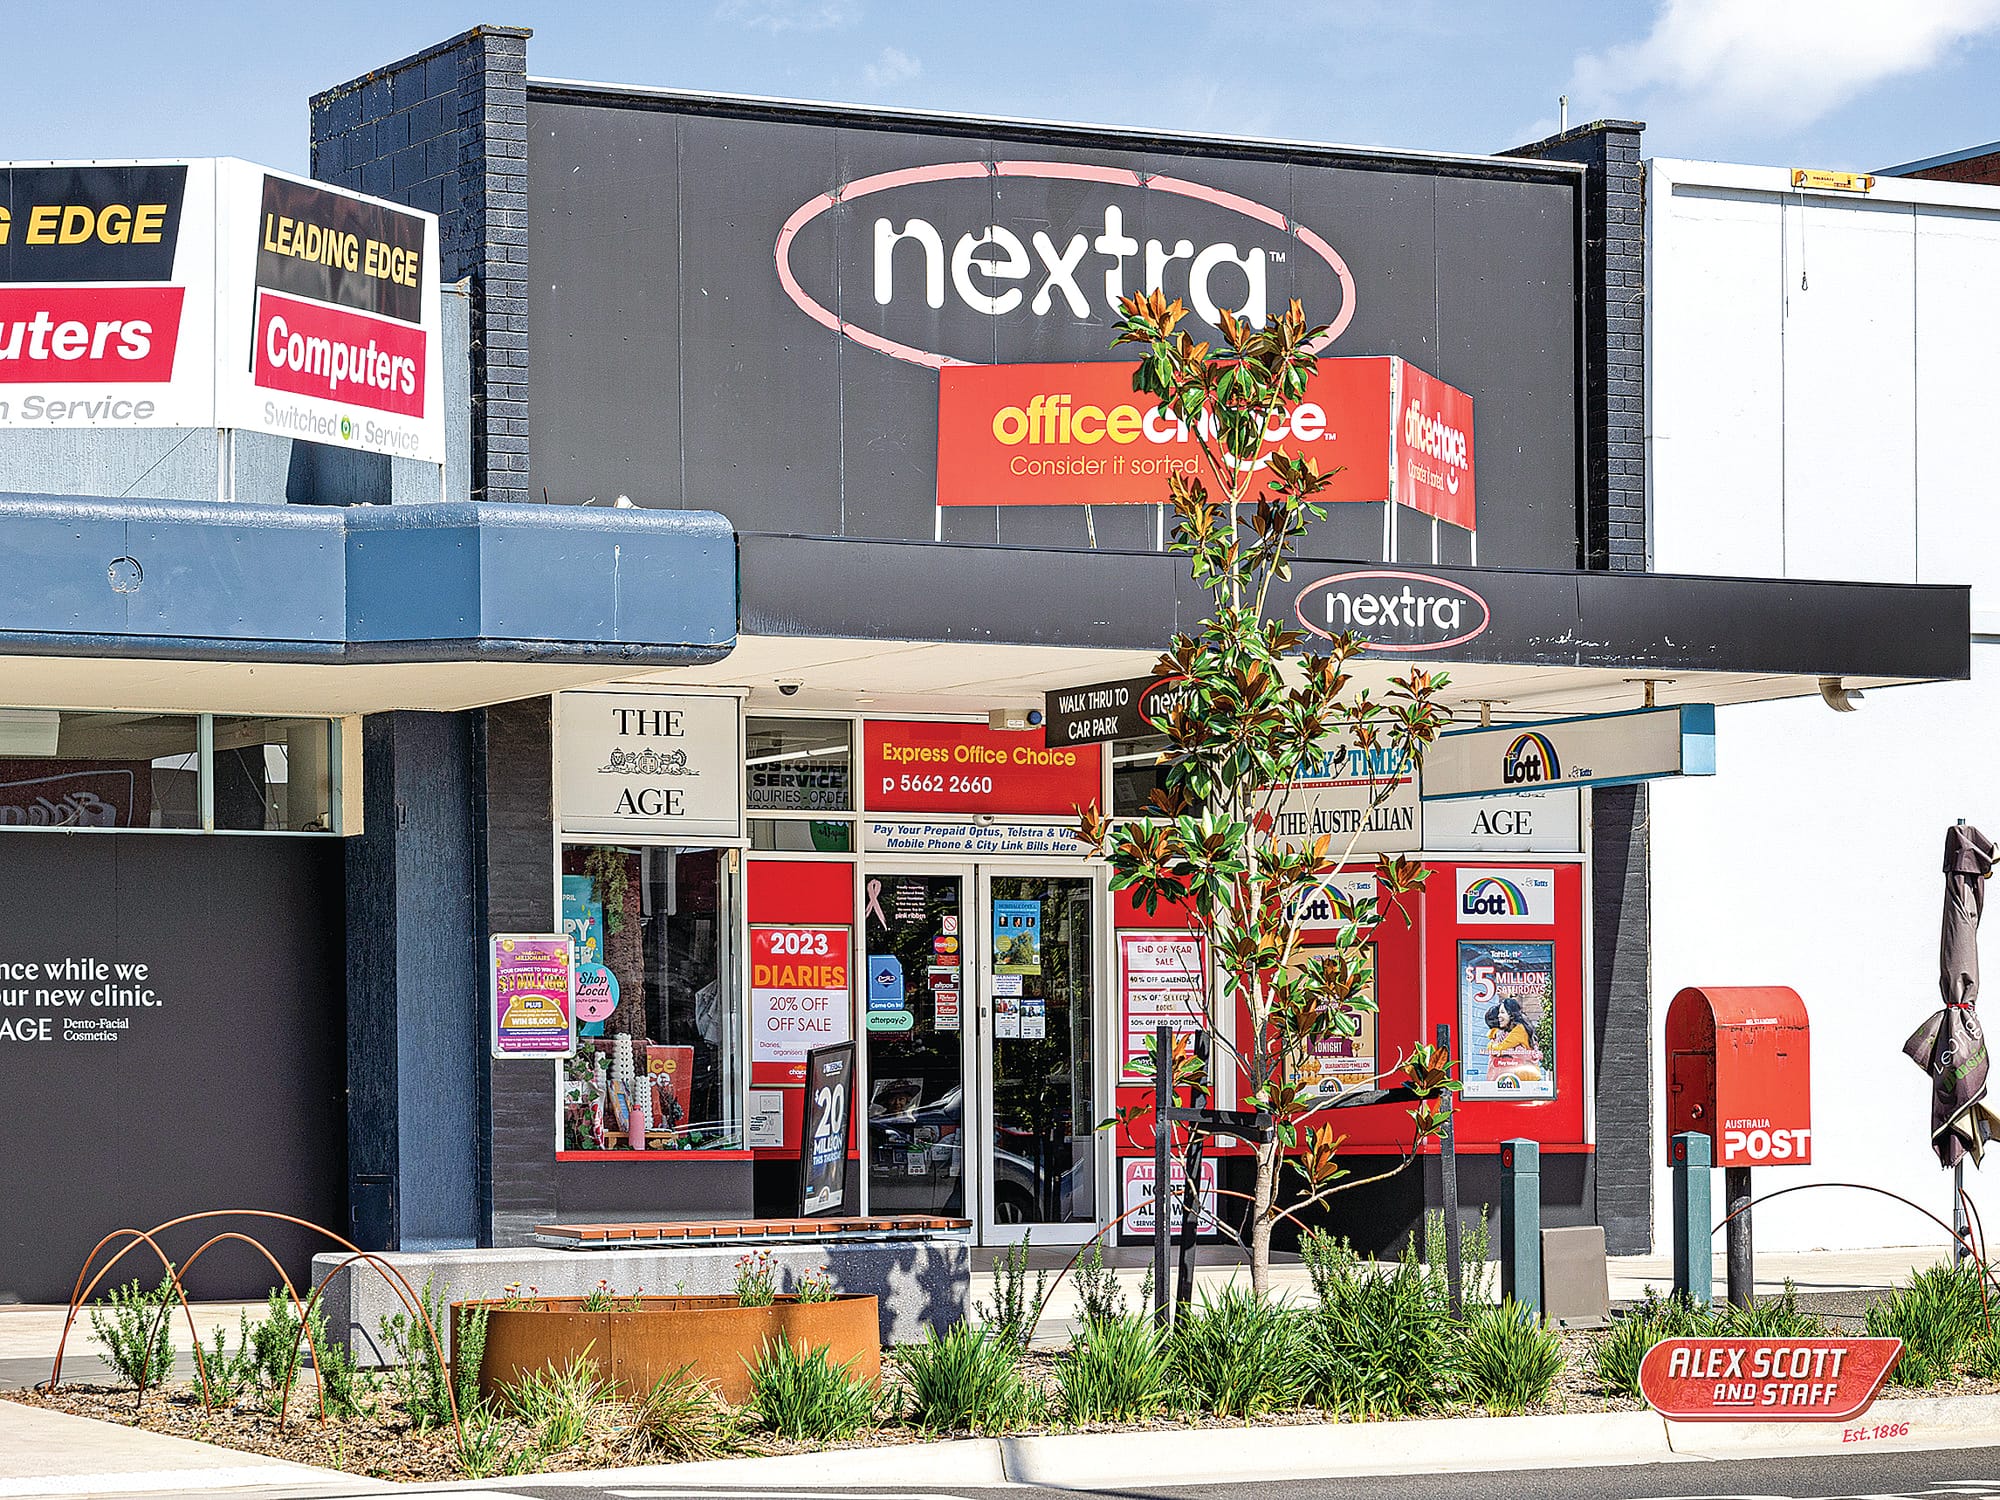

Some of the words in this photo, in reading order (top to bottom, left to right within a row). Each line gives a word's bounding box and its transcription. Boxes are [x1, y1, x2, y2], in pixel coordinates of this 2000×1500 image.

[26, 204, 167, 244] EDGE
[264, 213, 358, 272] LEADING
[364, 238, 418, 287] EDGE
[874, 204, 1268, 330] nextra
[267, 315, 415, 395] Computers
[21, 395, 155, 420] Service
[264, 400, 337, 437] Switched
[365, 420, 419, 451] Service
[1405, 398, 1466, 469] officechoice
[1011, 456, 1106, 476] Consider
[1113, 457, 1126, 475] it
[1131, 454, 1204, 475] sorted.
[1326, 586, 1461, 629] nextra
[1059, 693, 1086, 714] WALK
[1088, 689, 1113, 711] THRU
[1115, 688, 1129, 706] TO
[612, 709, 684, 736] THE
[1068, 719, 1090, 740] CAR
[1092, 716, 1119, 737] PARK
[883, 743, 949, 764] Express
[954, 745, 1007, 764] Office
[1013, 747, 1076, 766] Choice
[753, 773, 843, 788] SERVICE
[1504, 755, 1540, 784] Lott
[882, 777, 895, 794] p
[900, 775, 943, 792] 5662
[950, 776, 992, 793] 2660
[614, 788, 684, 816] AGE
[874, 825, 893, 836] Pay
[898, 825, 921, 835] Your
[924, 826, 966, 837] Prepaid
[969, 826, 1003, 838] Optus,
[1008, 827, 1043, 837] Telstra
[1047, 828, 1054, 837] &
[1280, 813, 1307, 835] THE
[1312, 807, 1413, 834] AUSTRALIAN
[1471, 810, 1533, 835] AGE
[887, 839, 924, 848] Mobile
[928, 839, 960, 849] Phone
[965, 840, 973, 849] &
[976, 841, 998, 852] City
[1001, 841, 1023, 850] Link
[1027, 842, 1049, 851] Bills
[1052, 842, 1077, 851] Here
[1463, 894, 1506, 915] Lott
[770, 932, 828, 955] 2023
[44, 958, 109, 981] while
[114, 964, 149, 981] we
[579, 971, 607, 986] Shop
[754, 964, 845, 987] DIARIES
[0, 989, 29, 1006] ur
[36, 989, 85, 1006] new
[90, 984, 162, 1007] clinic.
[576, 984, 610, 996] Local
[1496, 985, 1545, 994] SATURDAYS
[770, 997, 798, 1011] 20%
[801, 998, 828, 1011] OFF
[64, 1018, 129, 1029] Dento-Facial
[767, 1017, 794, 1031] OFF
[797, 1018, 831, 1031] SALE
[63, 1031, 118, 1041] Cosmetics
[1725, 1119, 1770, 1129] AUSTRALIA
[814, 1133, 842, 1155] MILLION
[1725, 1129, 1811, 1160] POST
